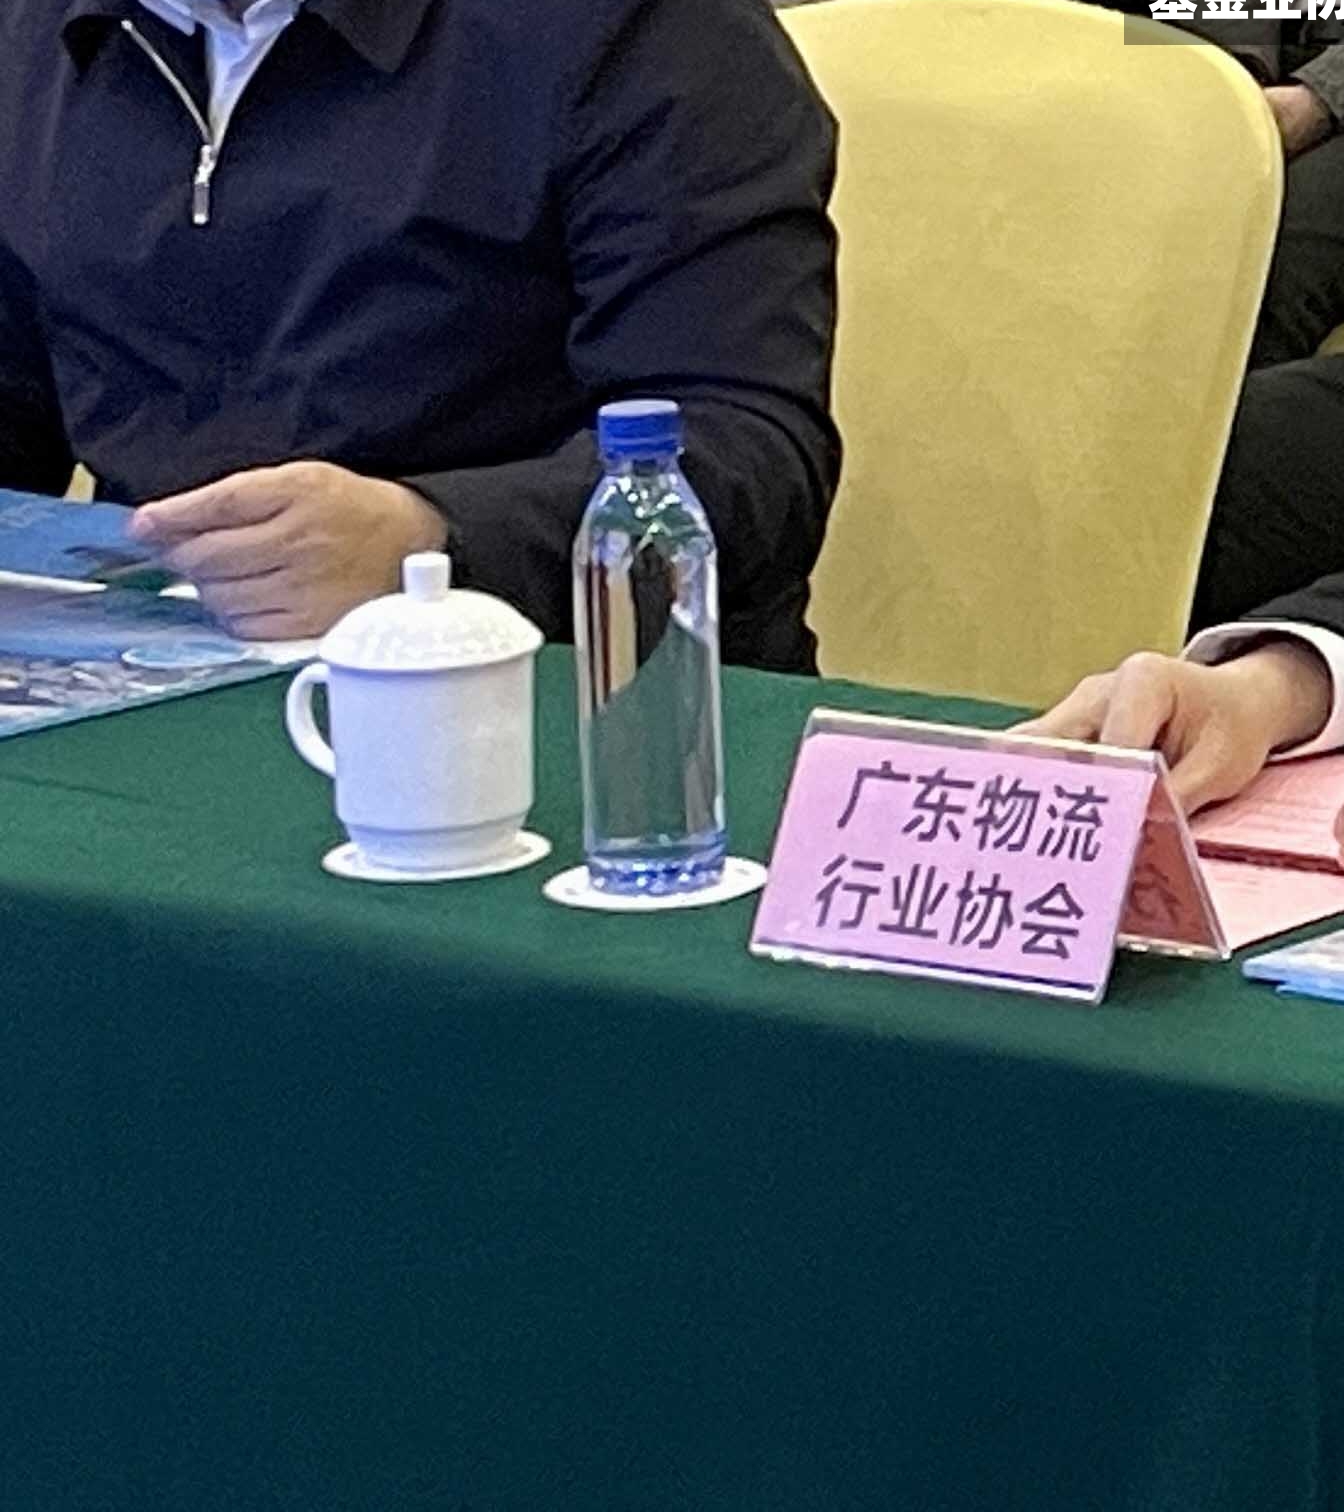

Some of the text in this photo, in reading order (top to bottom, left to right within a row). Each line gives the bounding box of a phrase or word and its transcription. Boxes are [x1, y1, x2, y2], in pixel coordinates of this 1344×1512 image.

[837, 761, 1110, 862] 广东物流
[815, 854, 1086, 960] 行业协会
